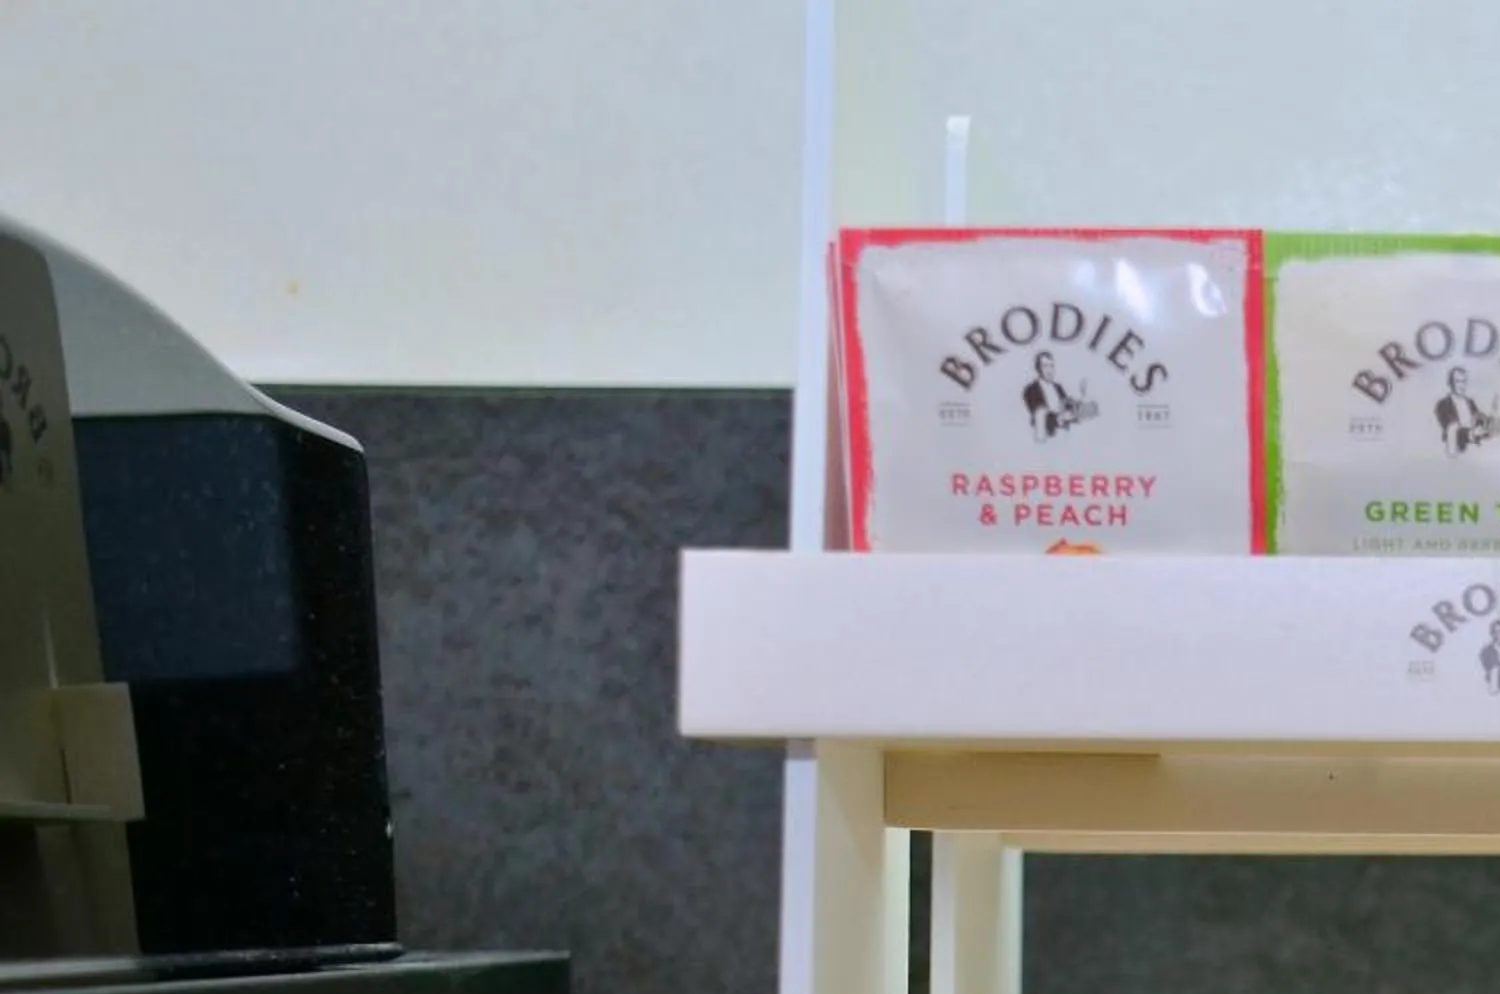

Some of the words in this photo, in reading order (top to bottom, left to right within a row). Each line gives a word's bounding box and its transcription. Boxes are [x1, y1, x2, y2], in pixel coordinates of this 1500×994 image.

[939, 302, 1169, 395] BRODIES
[952, 474, 1158, 498] RASPBERRY
[980, 505, 997, 525] &
[1014, 504, 1129, 526] PEACH
[1365, 502, 1480, 524] GREEN
[1353, 539, 1405, 552] LIGHT
